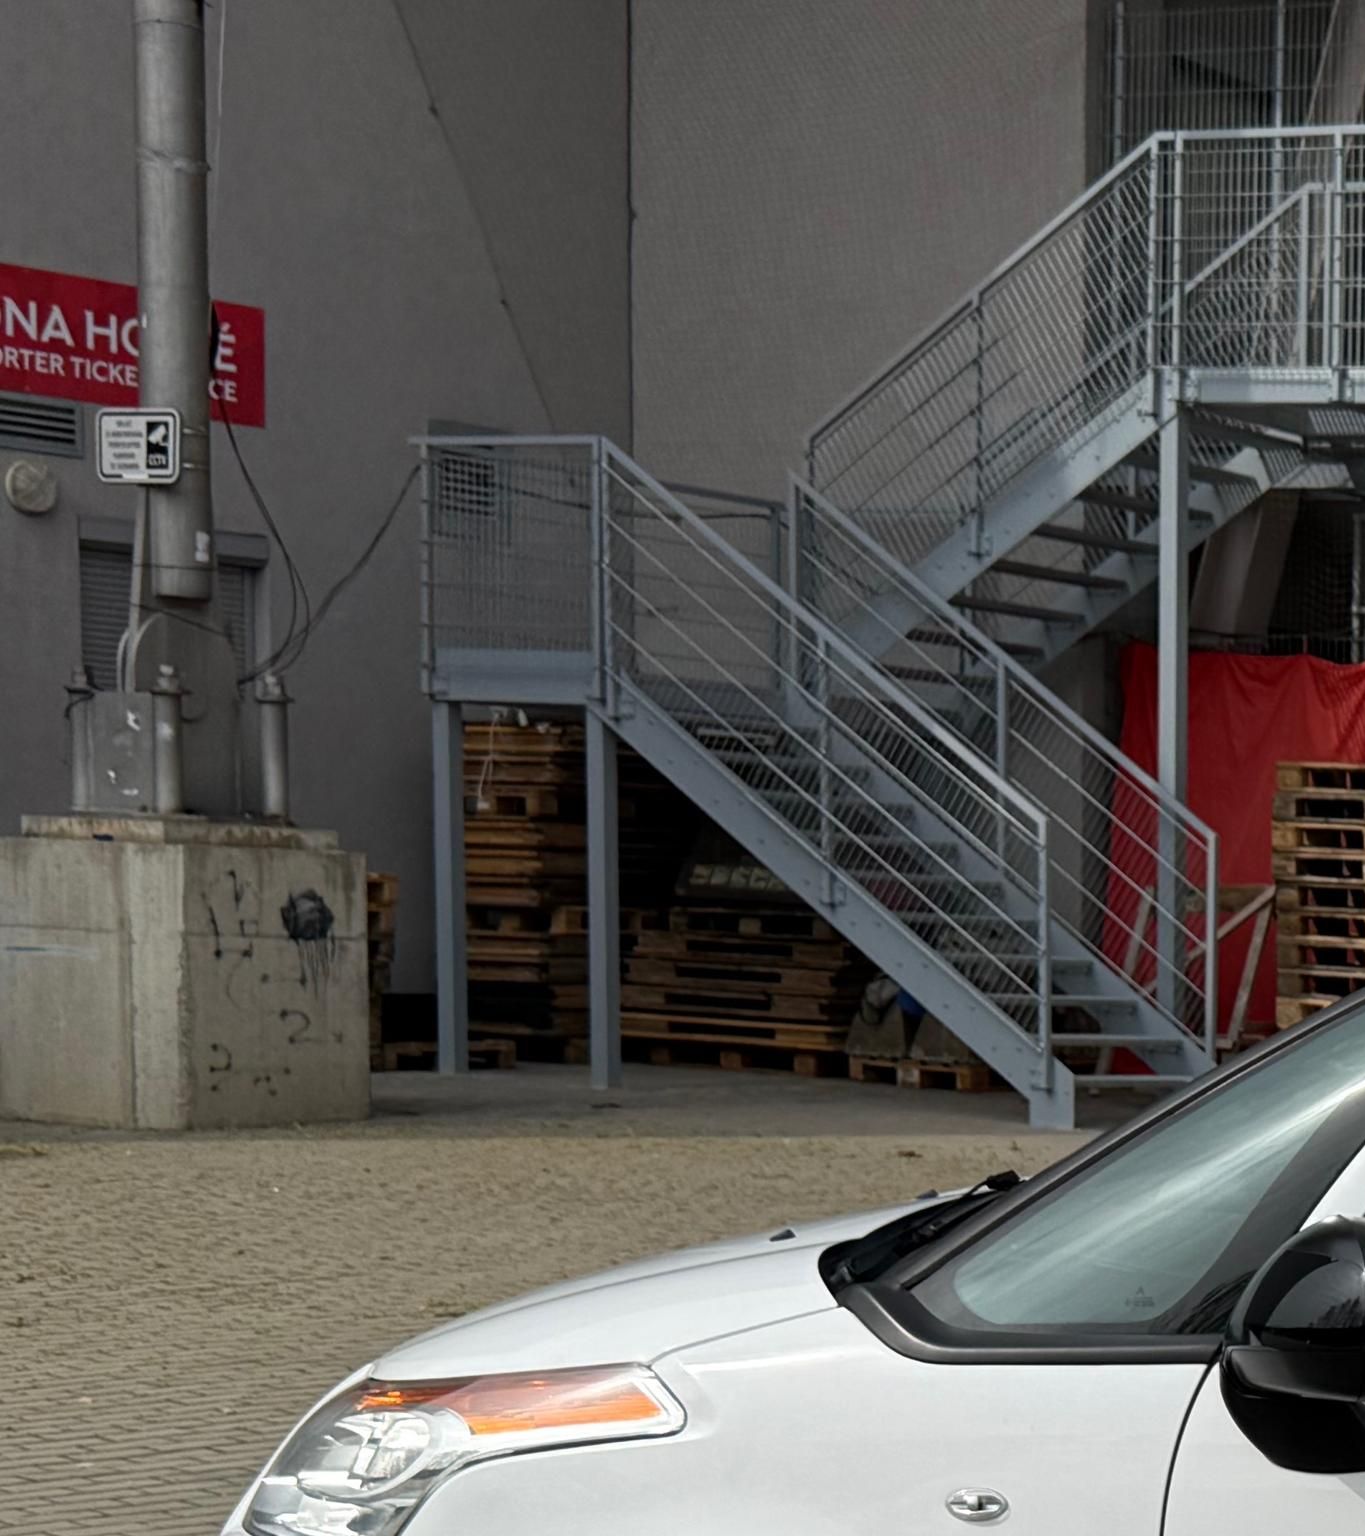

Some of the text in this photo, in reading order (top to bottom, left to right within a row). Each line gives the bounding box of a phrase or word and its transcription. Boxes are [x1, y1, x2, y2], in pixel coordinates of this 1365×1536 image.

[0, 295, 75, 348] NA
[0, 345, 65, 377] RTER
[70, 355, 139, 388] TICKE
